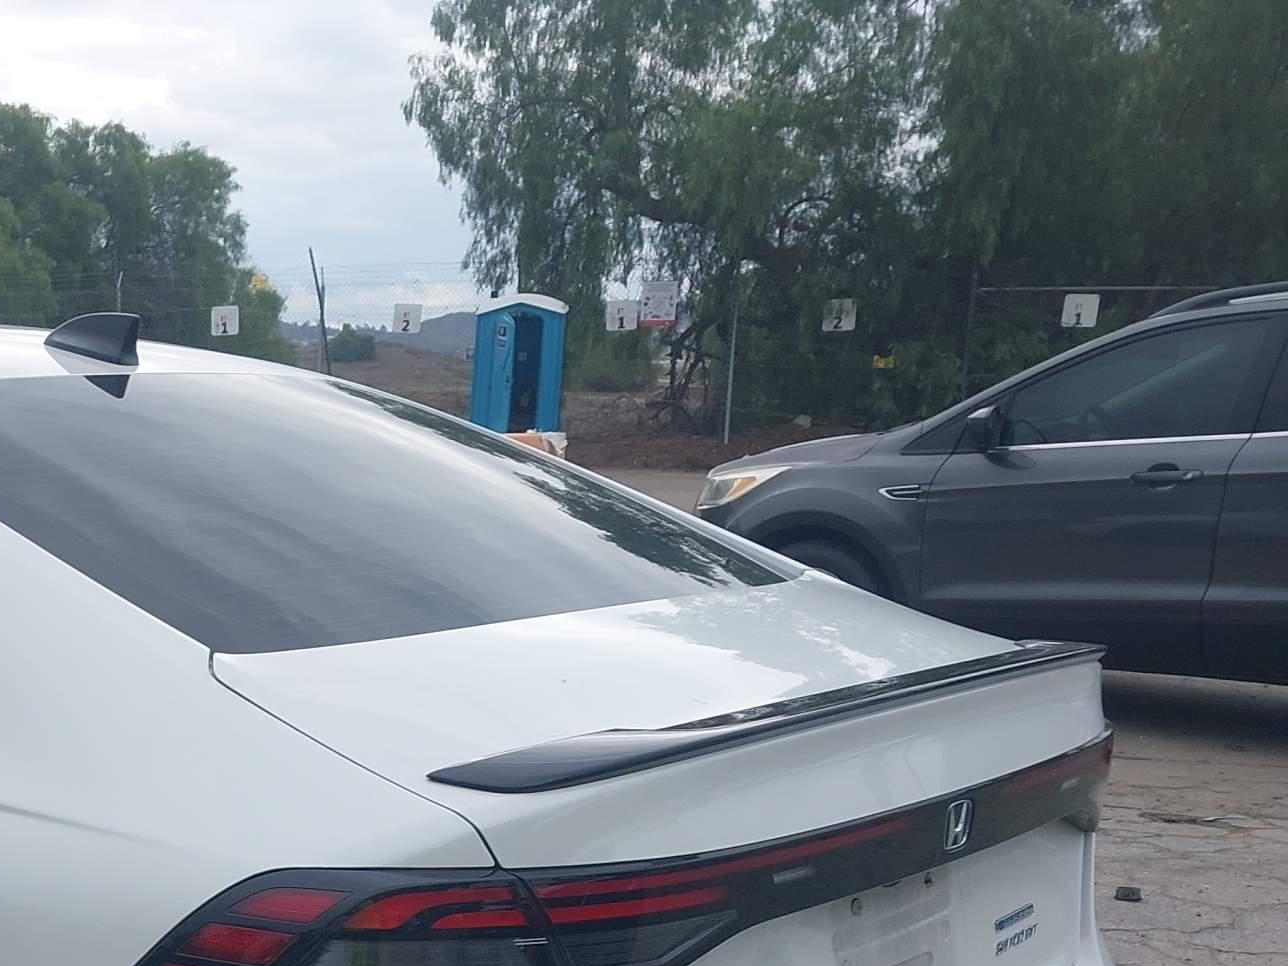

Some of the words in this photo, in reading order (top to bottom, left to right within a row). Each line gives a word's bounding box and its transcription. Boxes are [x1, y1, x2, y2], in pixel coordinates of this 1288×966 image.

[617, 316, 626, 329] 1
[833, 316, 843, 329] 2
[1073, 311, 1082, 326] 1
[221, 321, 229, 334] 1
[401, 319, 411, 332] 2
